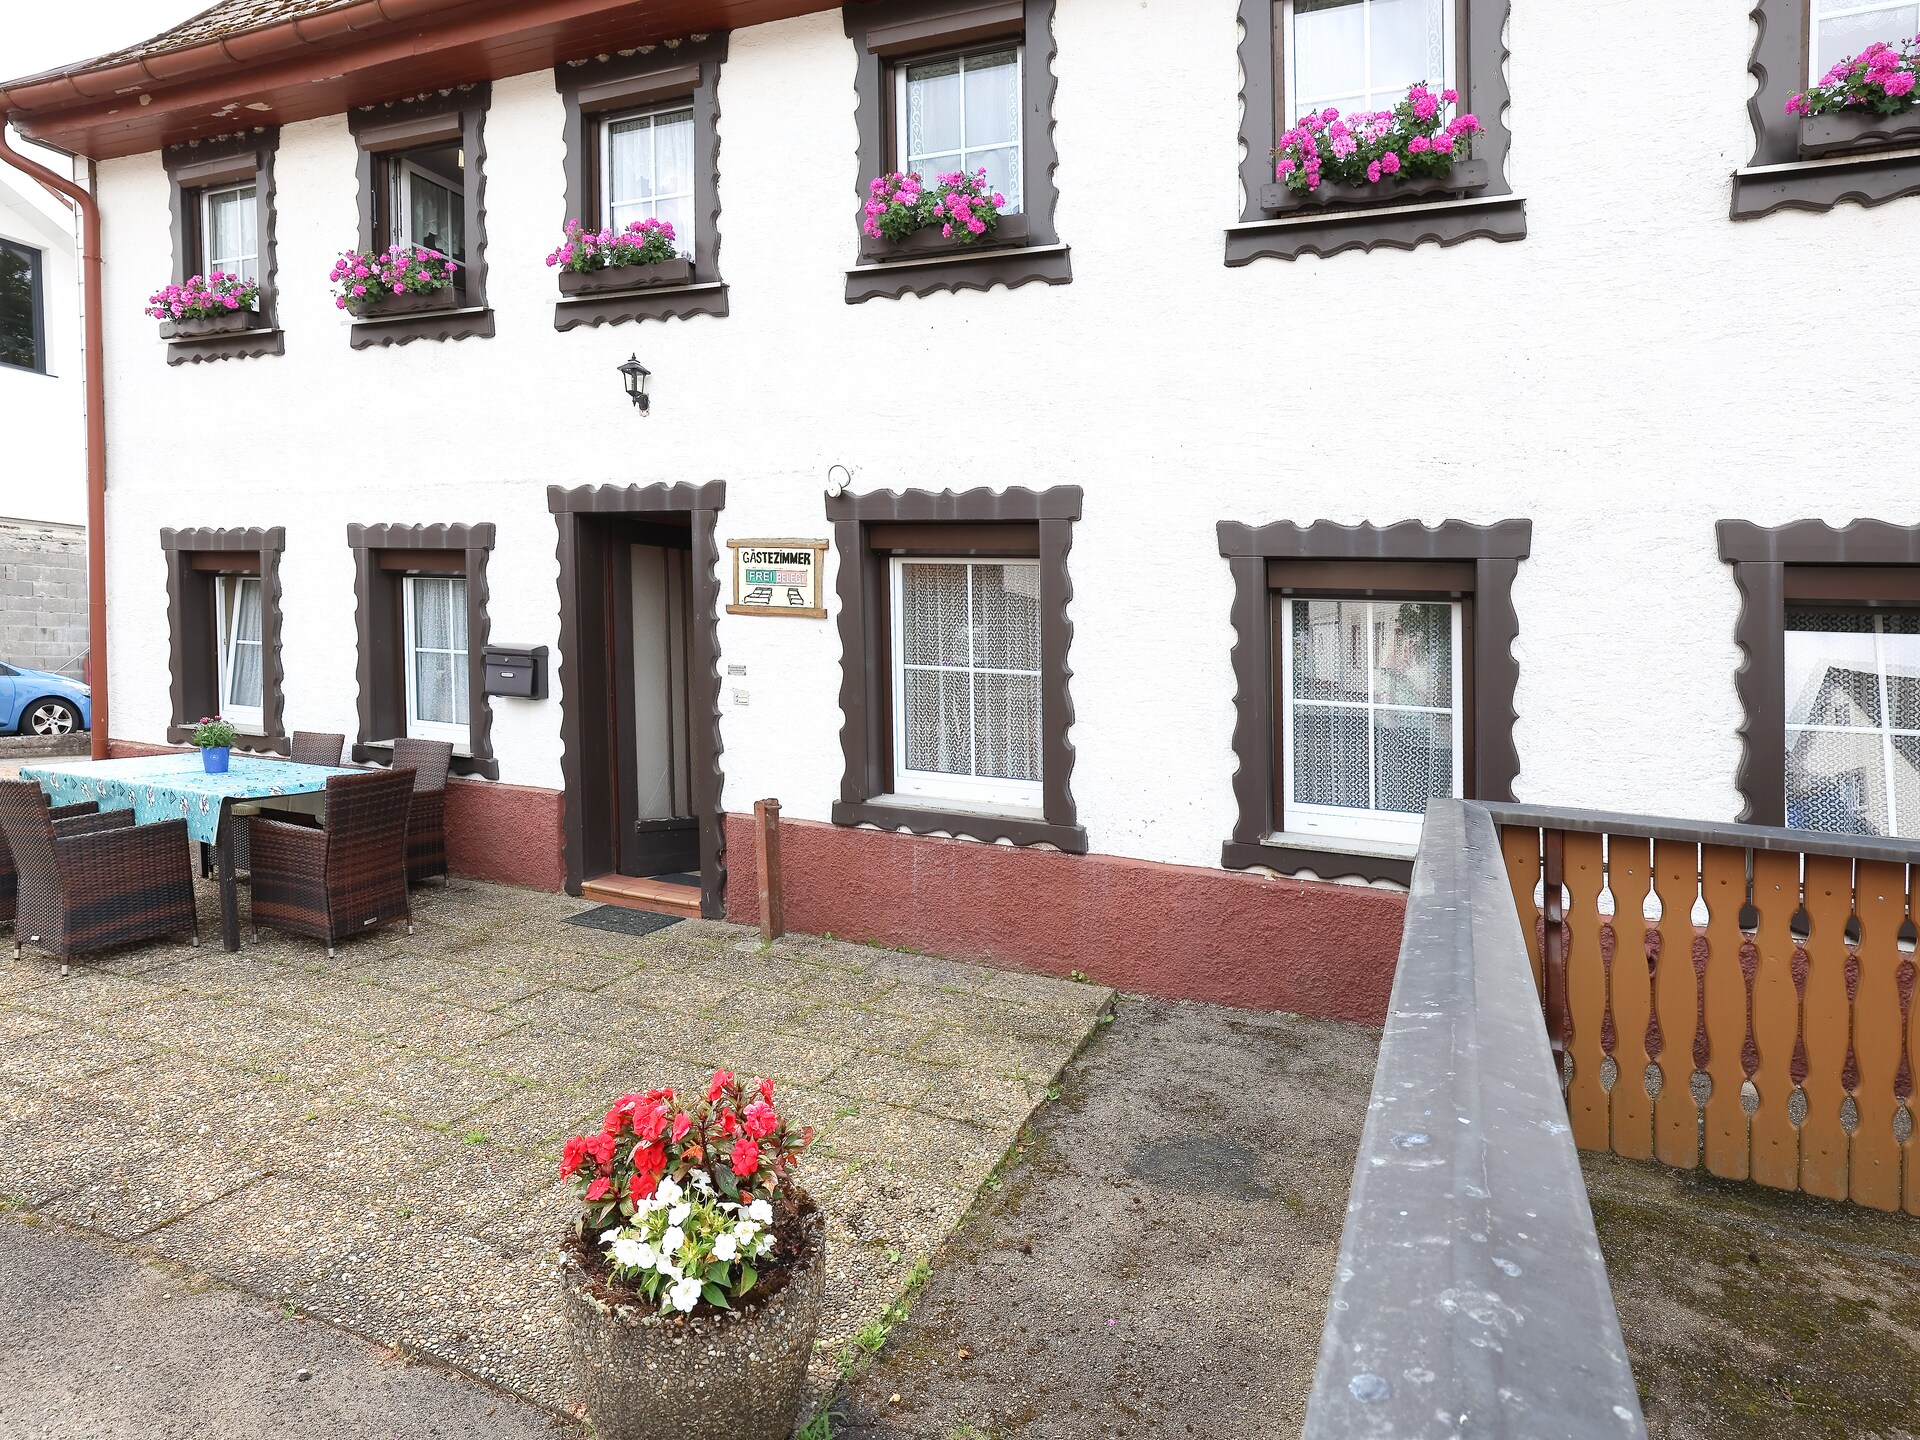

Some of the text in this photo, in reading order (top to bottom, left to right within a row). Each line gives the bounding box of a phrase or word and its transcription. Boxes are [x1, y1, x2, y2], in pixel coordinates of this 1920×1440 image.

[742, 549, 811, 565] GÄSTEZIMMER
[749, 571, 806, 583] FREI BELEGT
